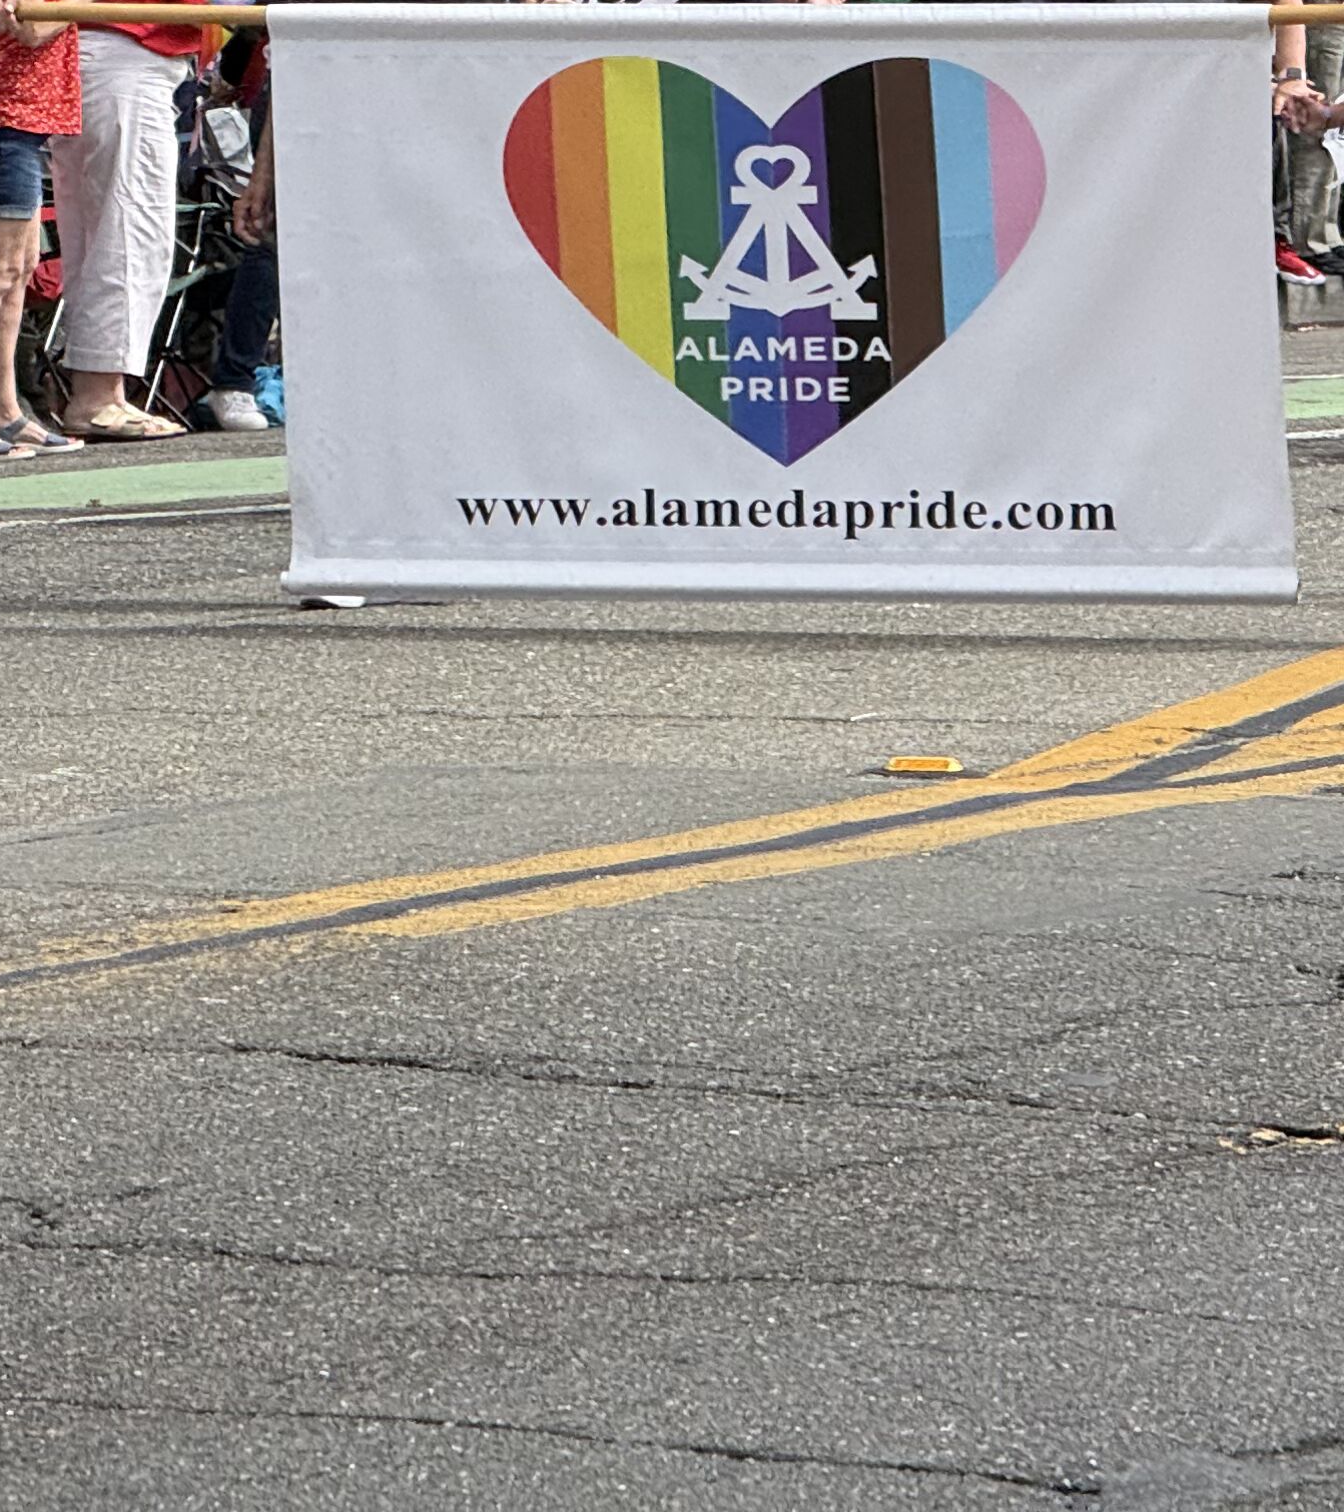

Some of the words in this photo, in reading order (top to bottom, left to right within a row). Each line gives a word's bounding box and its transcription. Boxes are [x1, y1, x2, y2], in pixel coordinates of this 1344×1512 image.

[674, 336, 893, 362] ALAMEDA
[720, 376, 851, 402] PRIDE
[456, 488, 1118, 540] www.alamedapride.com
